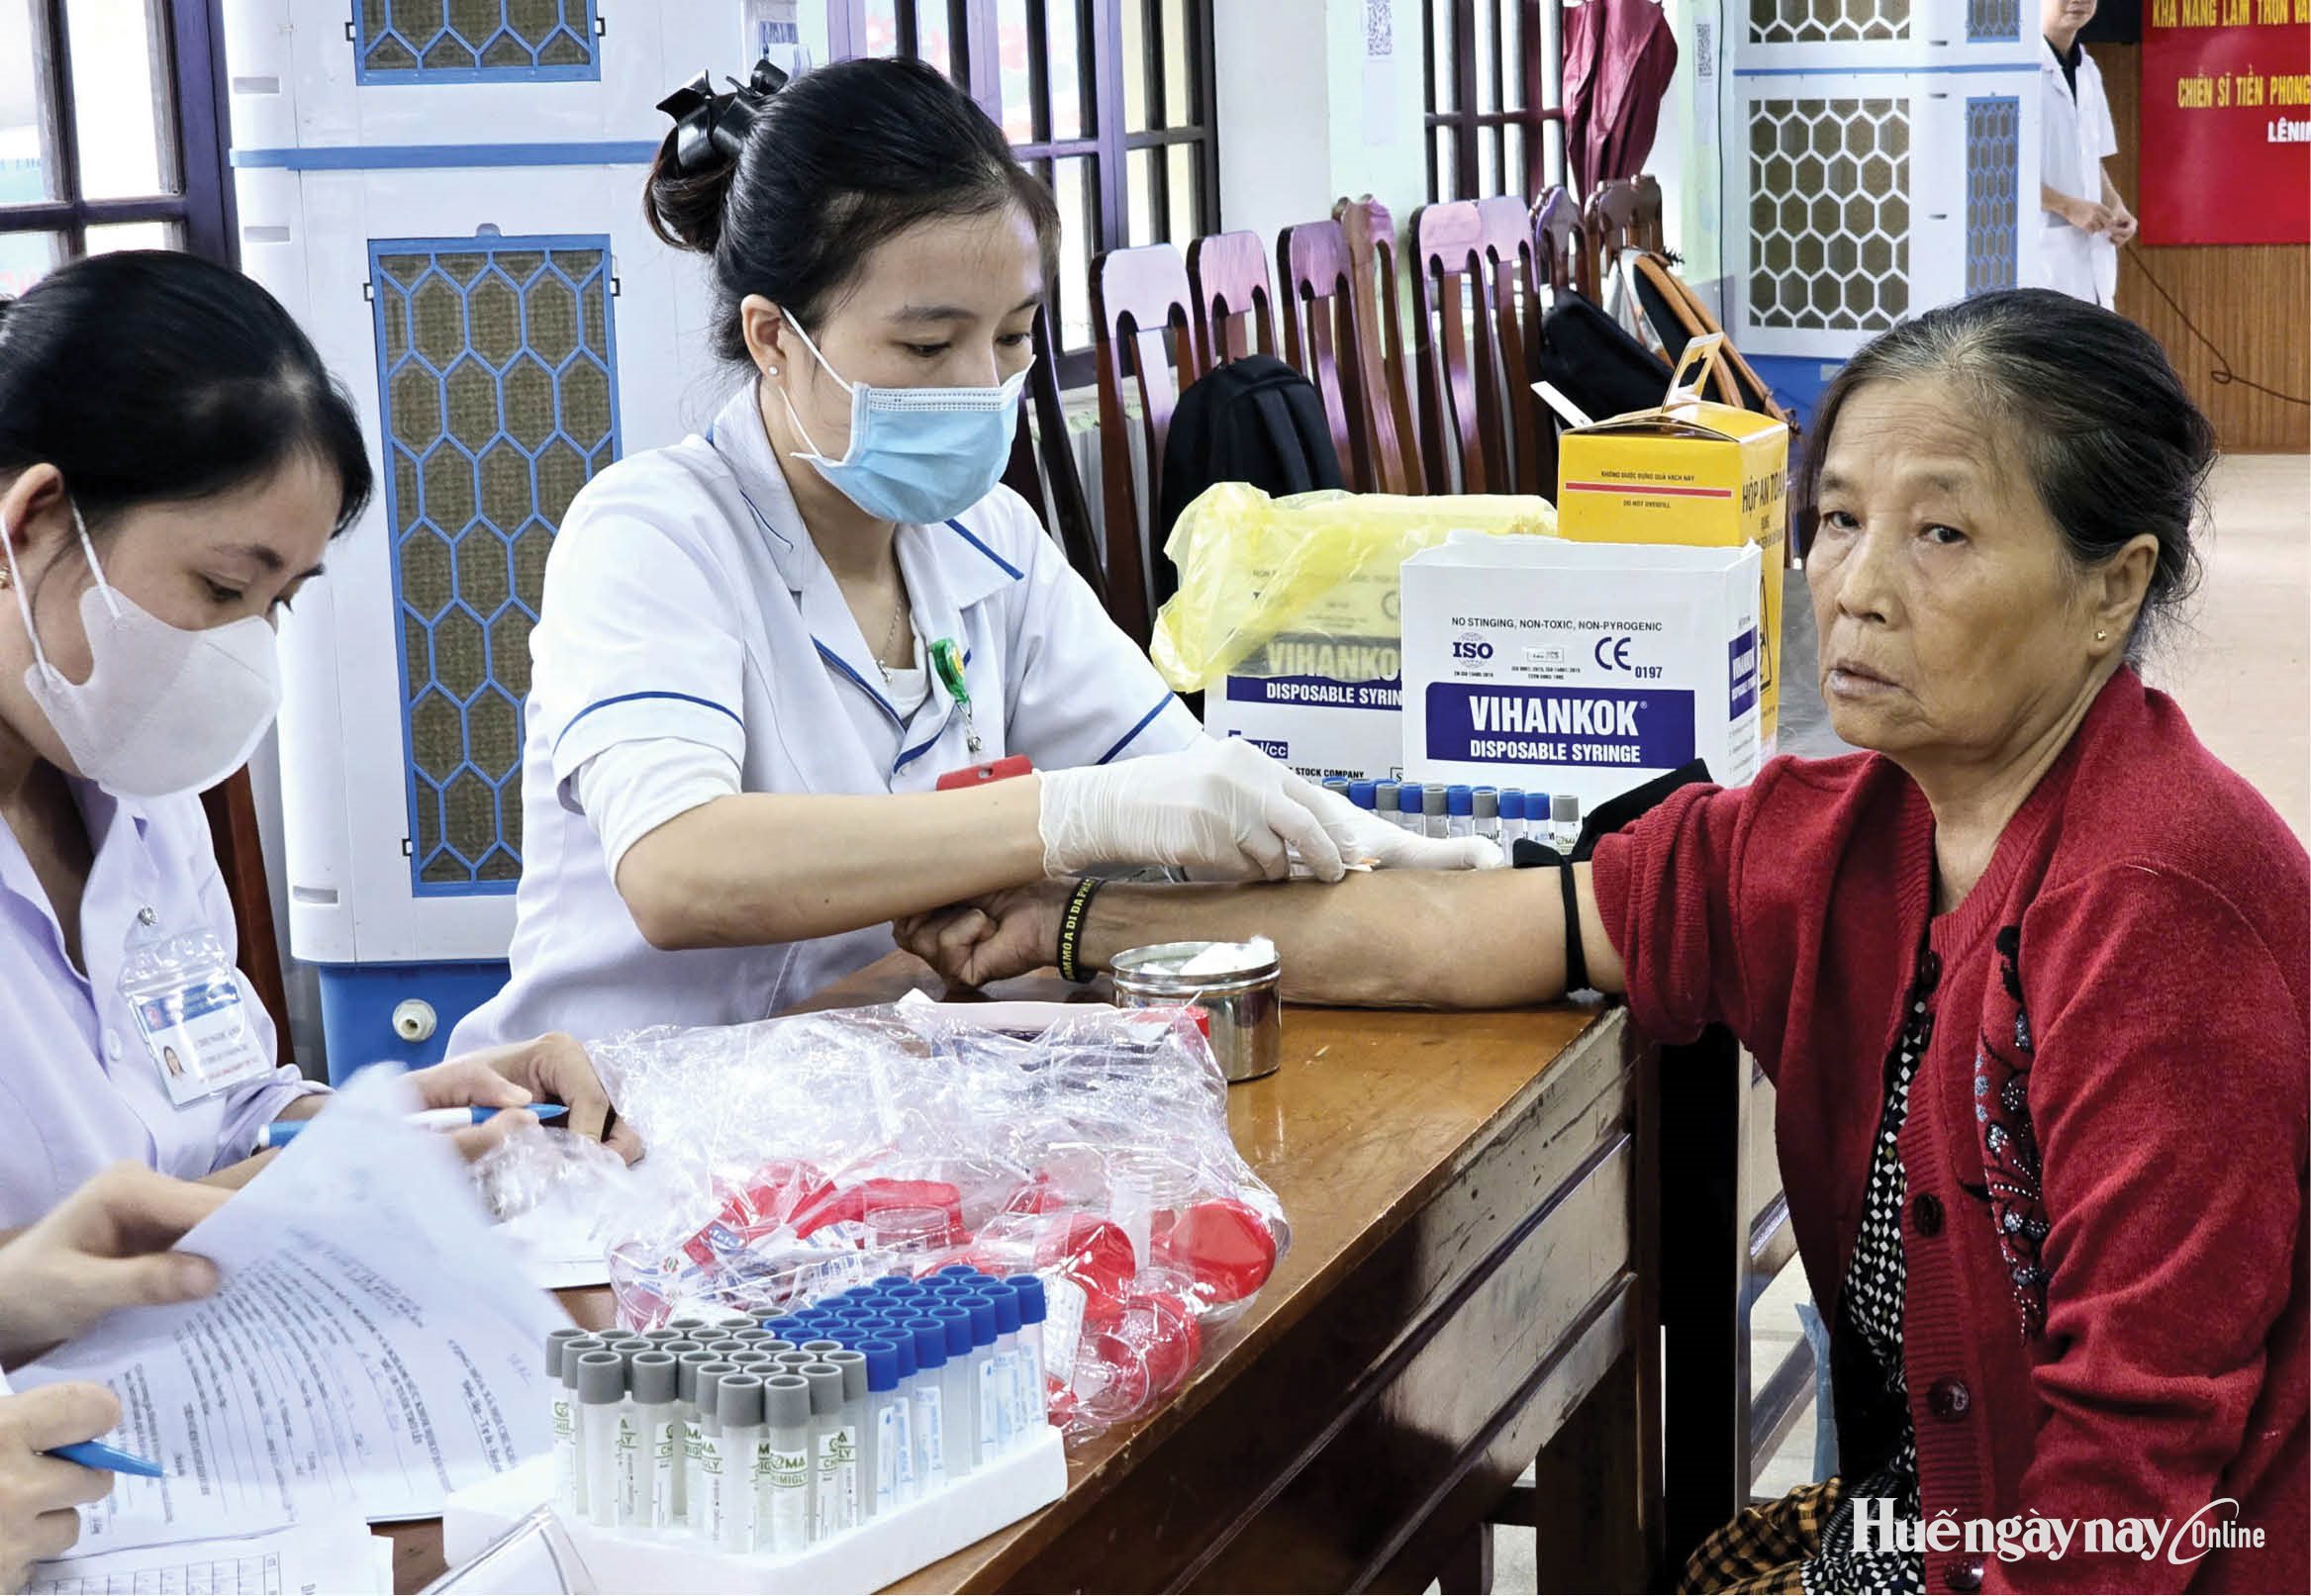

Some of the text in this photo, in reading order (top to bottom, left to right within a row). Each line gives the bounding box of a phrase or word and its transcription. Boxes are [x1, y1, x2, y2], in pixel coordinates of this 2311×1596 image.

[1452, 616, 1663, 632] NO STINGING, NON-TOXIC, NON-PYROGENIC
[1452, 641, 1494, 660] ISO
[1594, 636, 1632, 671] CE
[1268, 644, 1401, 682] VIHANKO
[1635, 666, 1663, 679] 0197
[1267, 682, 1401, 706] DISPOSABLE SYRIN
[1254, 743, 1287, 757] l/cc
[1470, 740, 1641, 764] DISPOSABLE SYRINGE
[1296, 767, 1321, 777] STOCK
[1323, 769, 1364, 779] COMPANY
